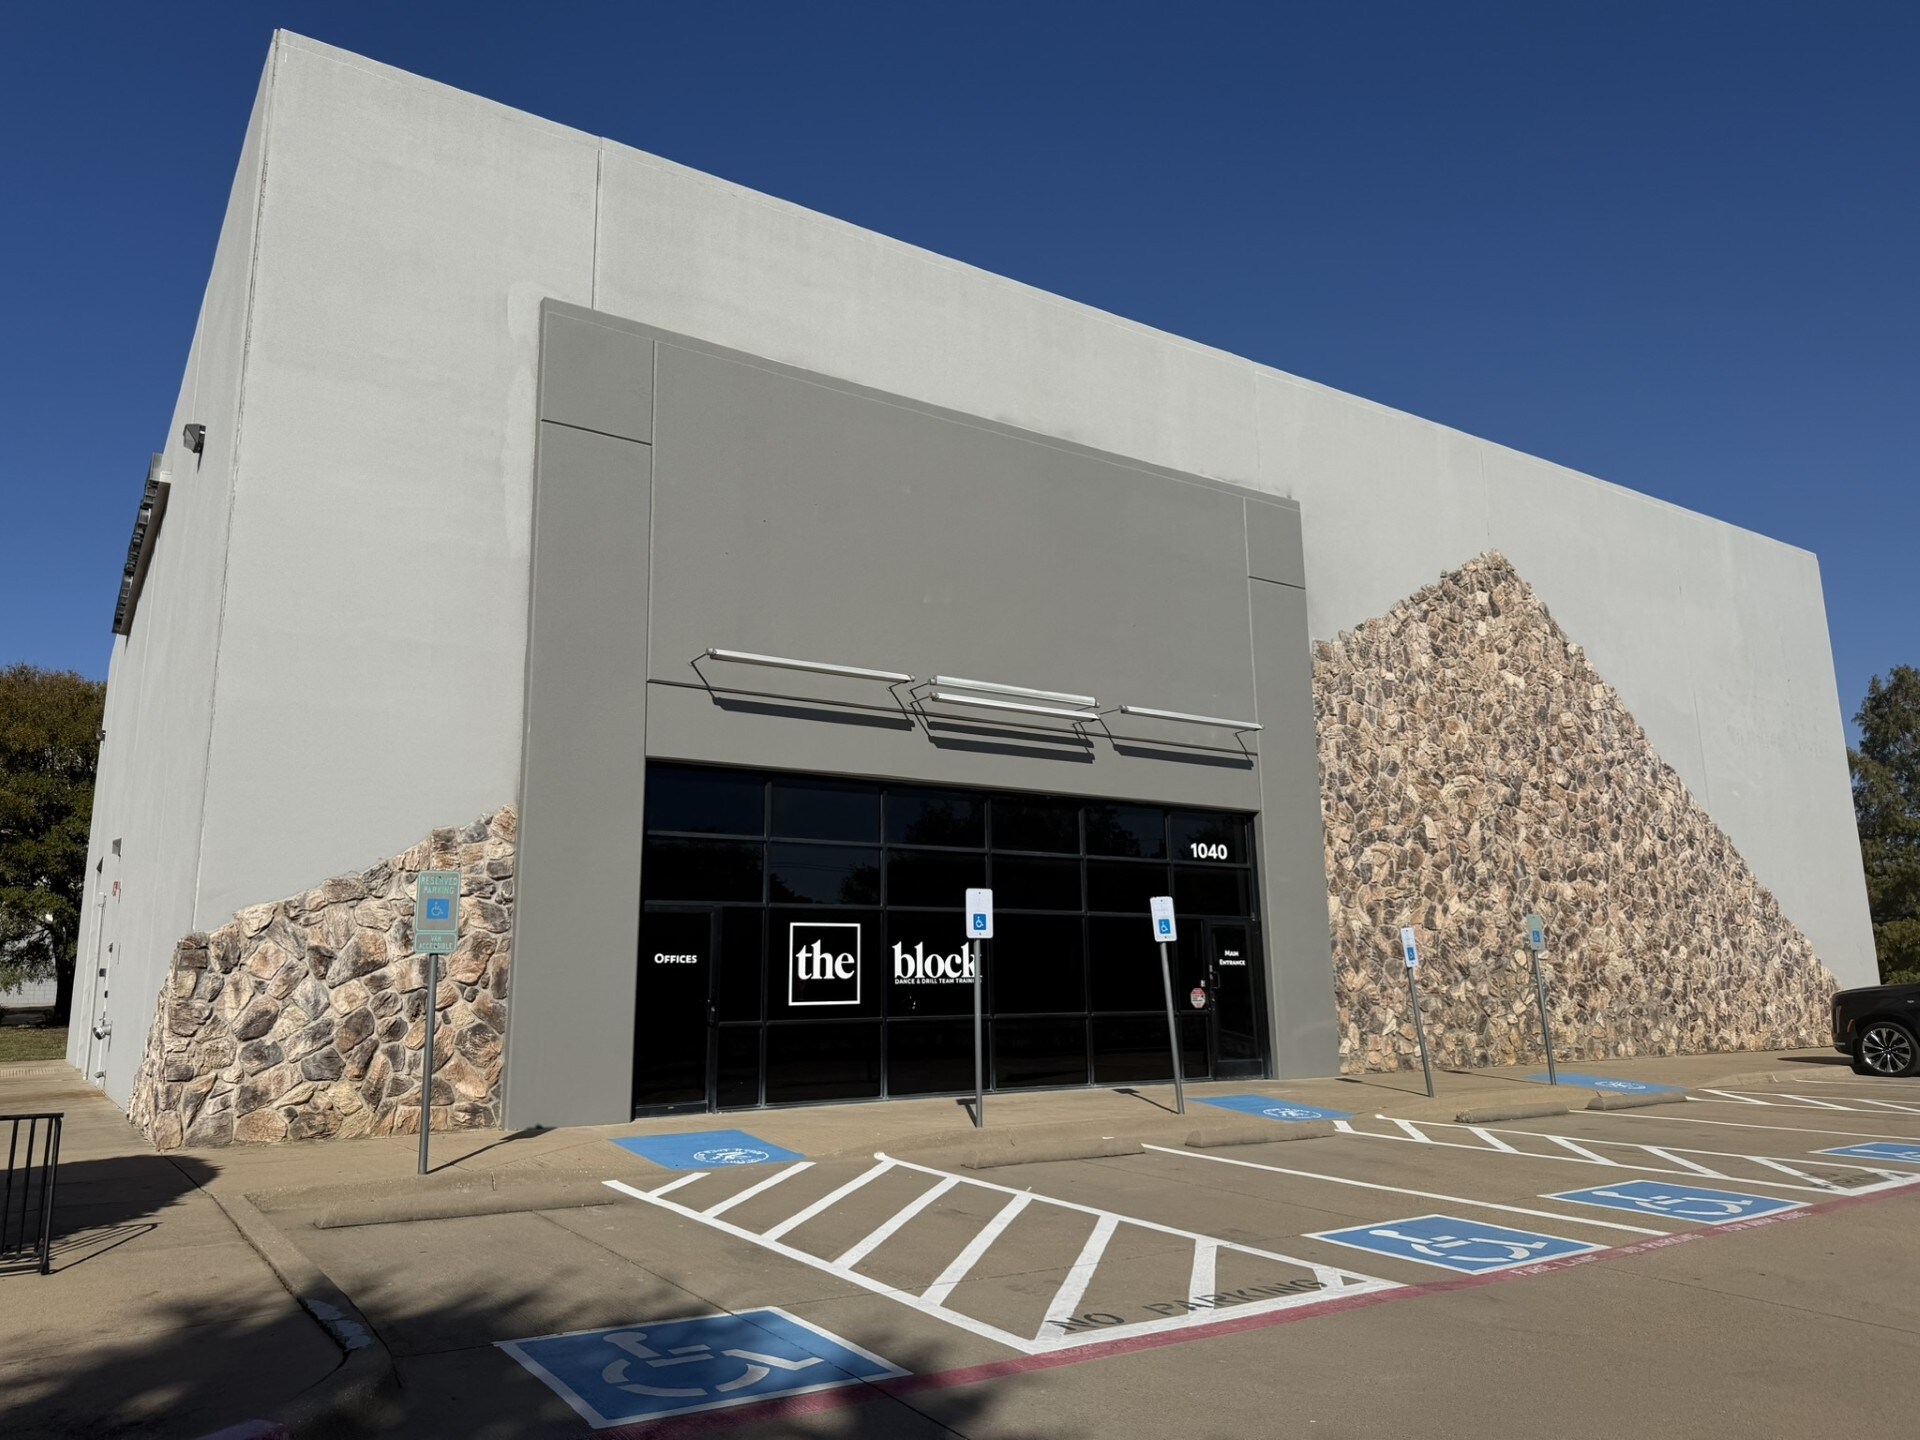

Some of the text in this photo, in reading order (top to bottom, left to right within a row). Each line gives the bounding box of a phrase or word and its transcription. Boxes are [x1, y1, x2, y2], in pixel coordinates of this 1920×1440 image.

[1190, 842, 1228, 860] 1040
[795, 938, 982, 981] the block
[1045, 1279, 1328, 1332] NO PARKING
